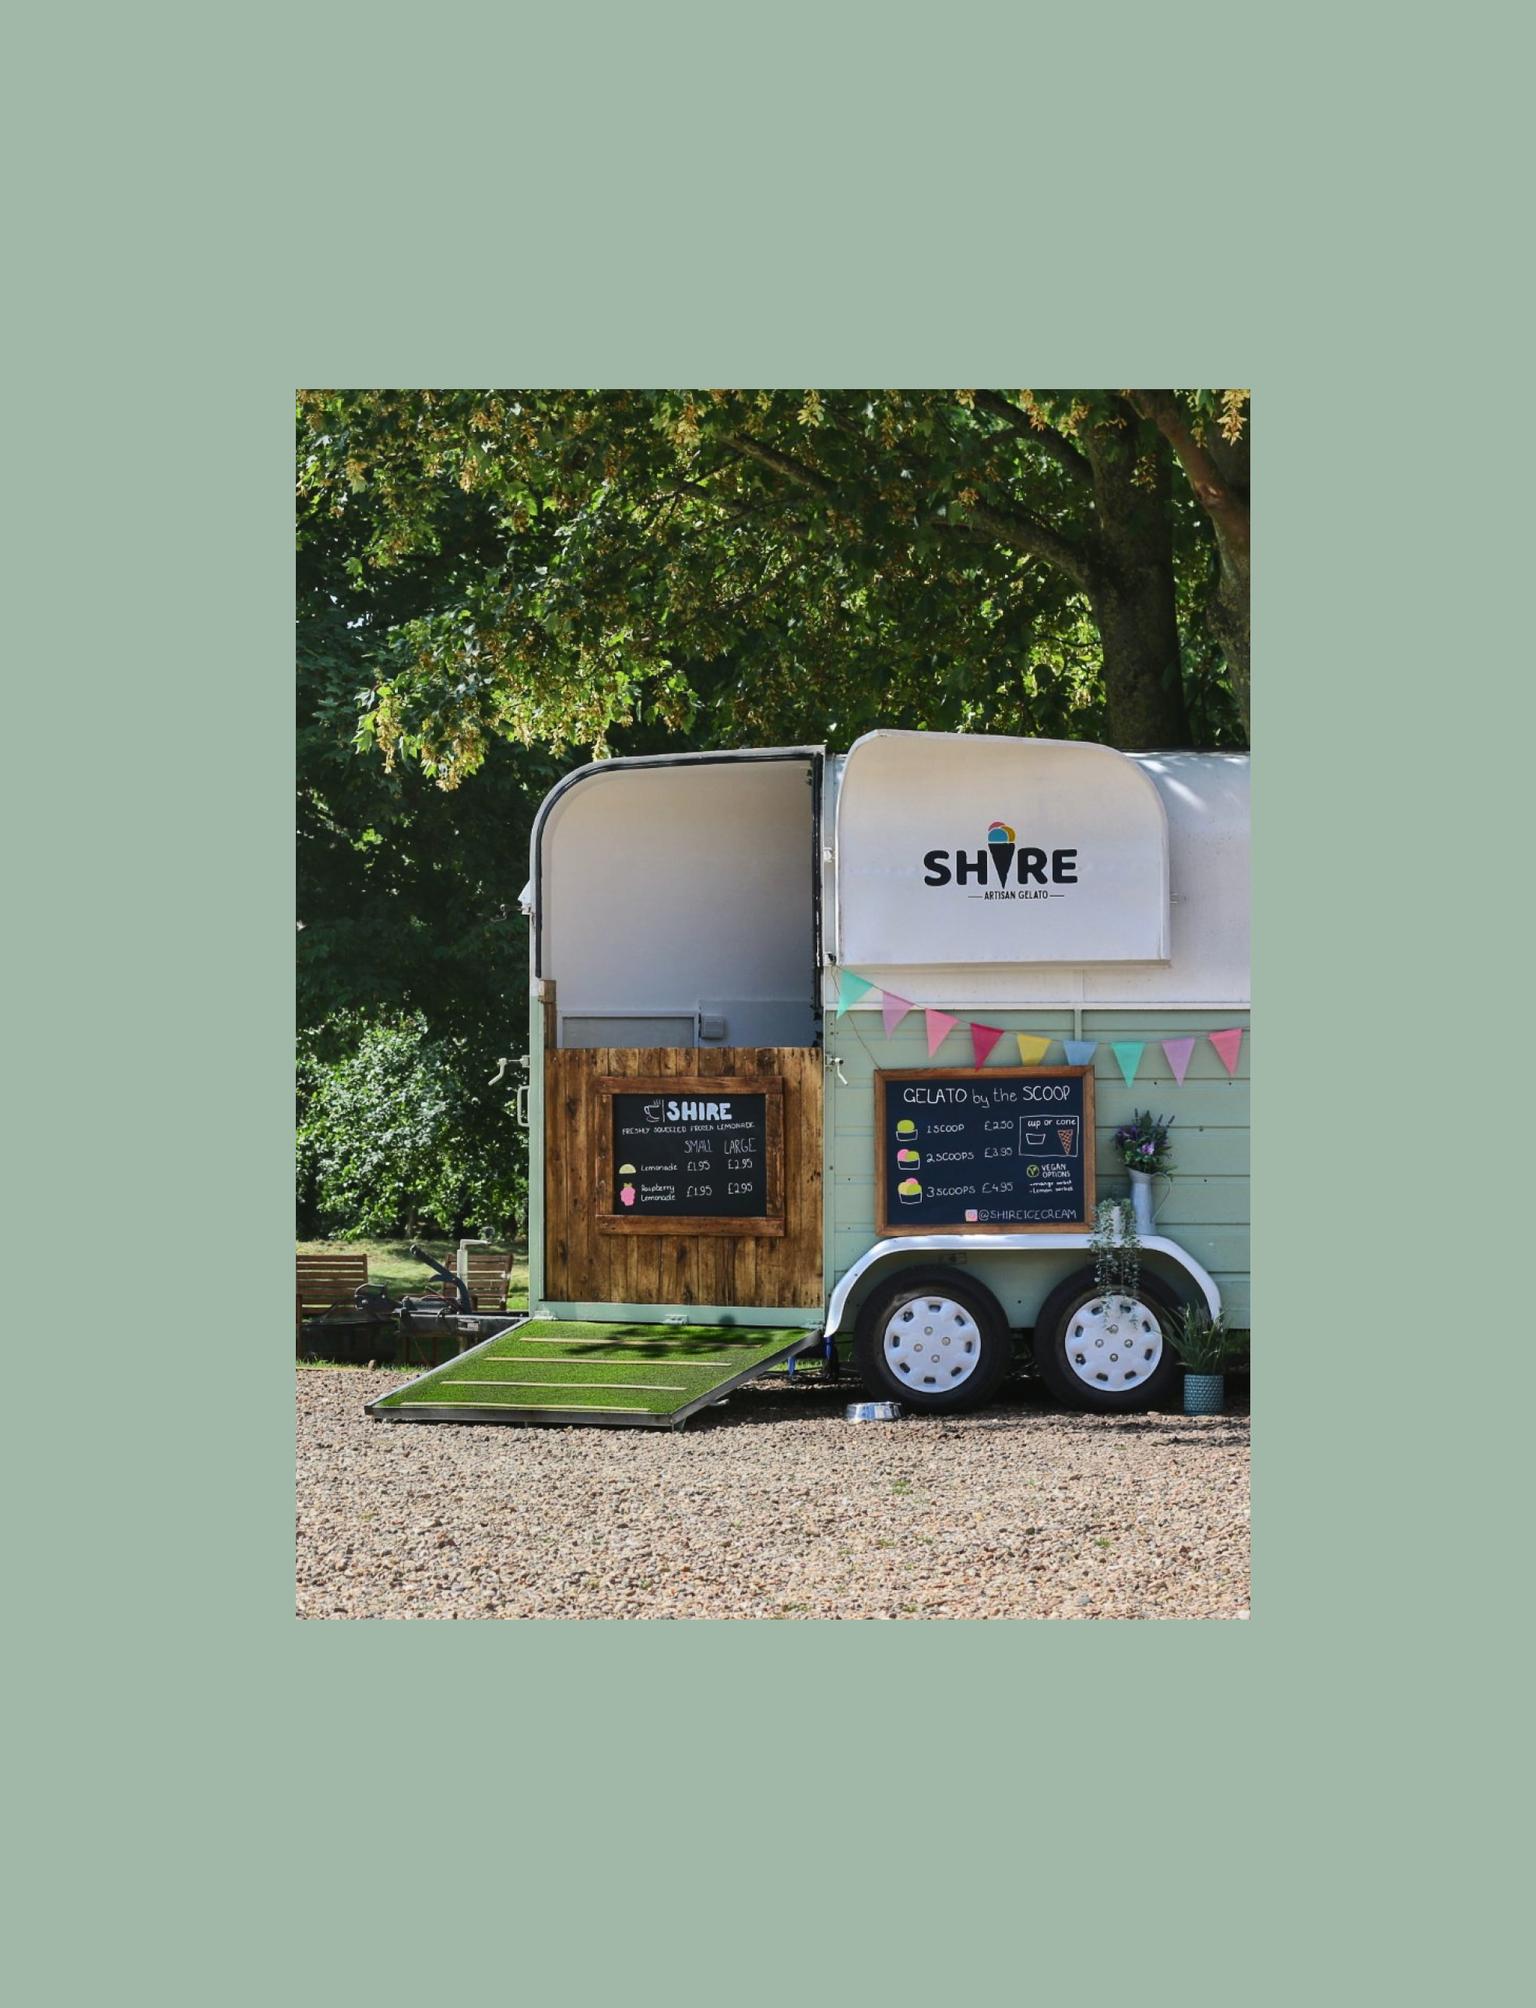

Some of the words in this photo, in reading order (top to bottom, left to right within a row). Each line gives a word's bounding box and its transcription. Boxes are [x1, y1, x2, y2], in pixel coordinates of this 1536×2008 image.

[984, 891, 1016, 900] ARTISAN
[1018, 890, 1048, 900] GELATO
[903, 1087, 967, 1104] GELATO
[972, 1088, 991, 1109] by
[993, 1088, 1018, 1102] the
[1022, 1085, 1071, 1101] SCOOP
[666, 1101, 732, 1121] SHIRE
[622, 1126, 650, 1136] FRESHLY
[716, 1121, 755, 1131] LEMONADE
[1027, 1119, 1041, 1129] cup
[1056, 1118, 1077, 1126] cone
[684, 1139, 713, 1153] SMALL
[724, 1138, 757, 1155] LARGE
[1041, 1163, 1067, 1171] VEGAN
[641, 1194, 676, 1202] Lemonade
